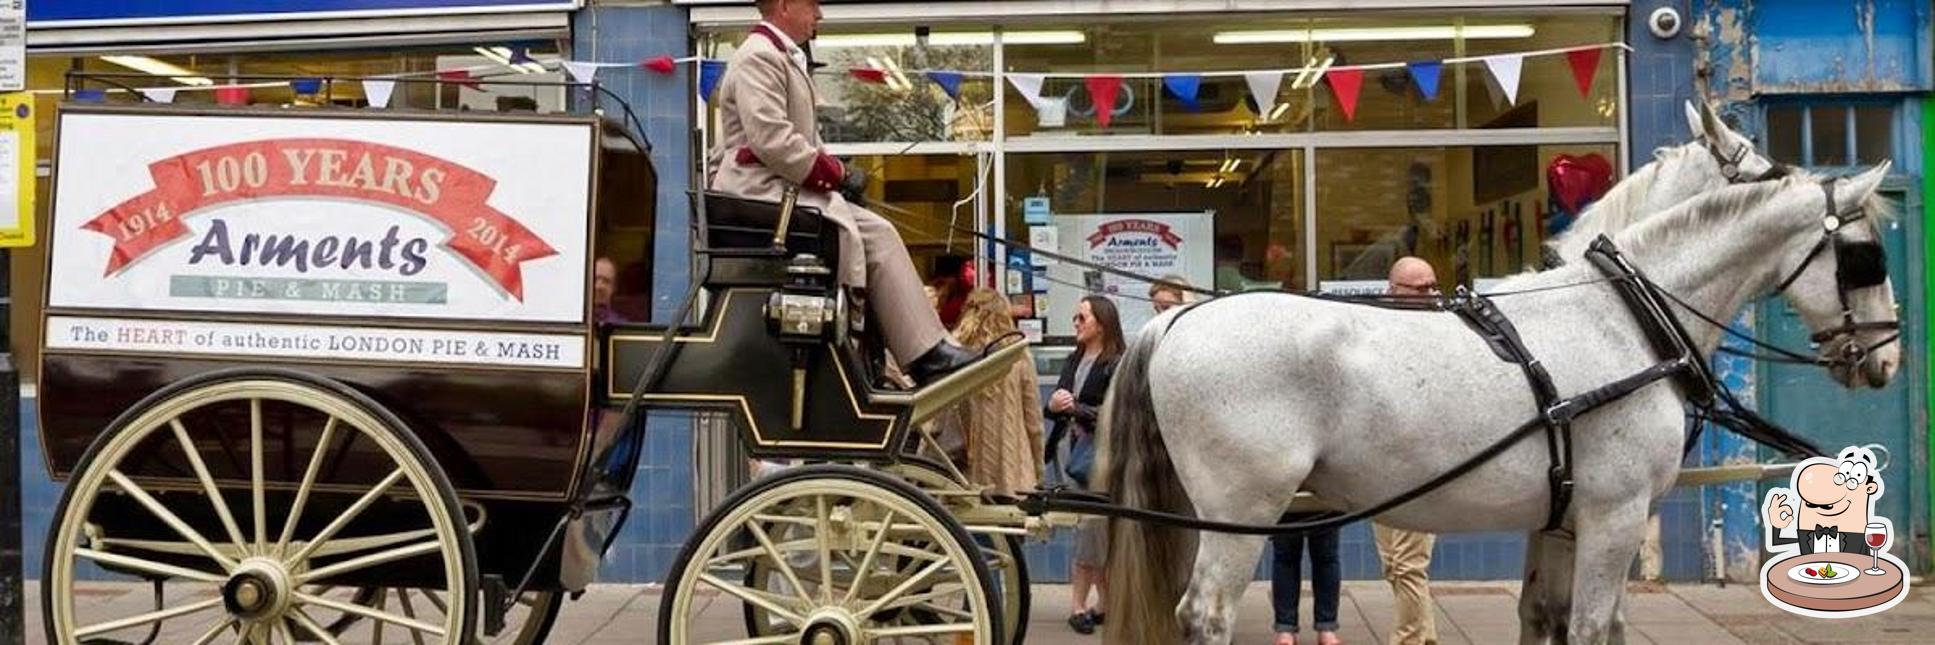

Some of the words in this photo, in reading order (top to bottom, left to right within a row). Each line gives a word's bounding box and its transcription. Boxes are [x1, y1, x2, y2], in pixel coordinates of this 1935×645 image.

[196, 151, 268, 196] 100
[282, 148, 445, 204] YEARS
[117, 201, 172, 241] 1914
[467, 216, 523, 264] 2014
[189, 218, 428, 276] Arments
[1107, 236, 1159, 247] Arments
[215, 279, 265, 297] PIE
[285, 281, 301, 298] &
[322, 282, 405, 301] MASH
[70, 326, 108, 343] The
[117, 327, 188, 345] HEART
[194, 330, 214, 346] of
[222, 332, 321, 351] authentic
[328, 335, 423, 354] LONDON
[432, 338, 467, 356] PIE
[475, 341, 488, 357] &
[497, 342, 560, 359] MASH
